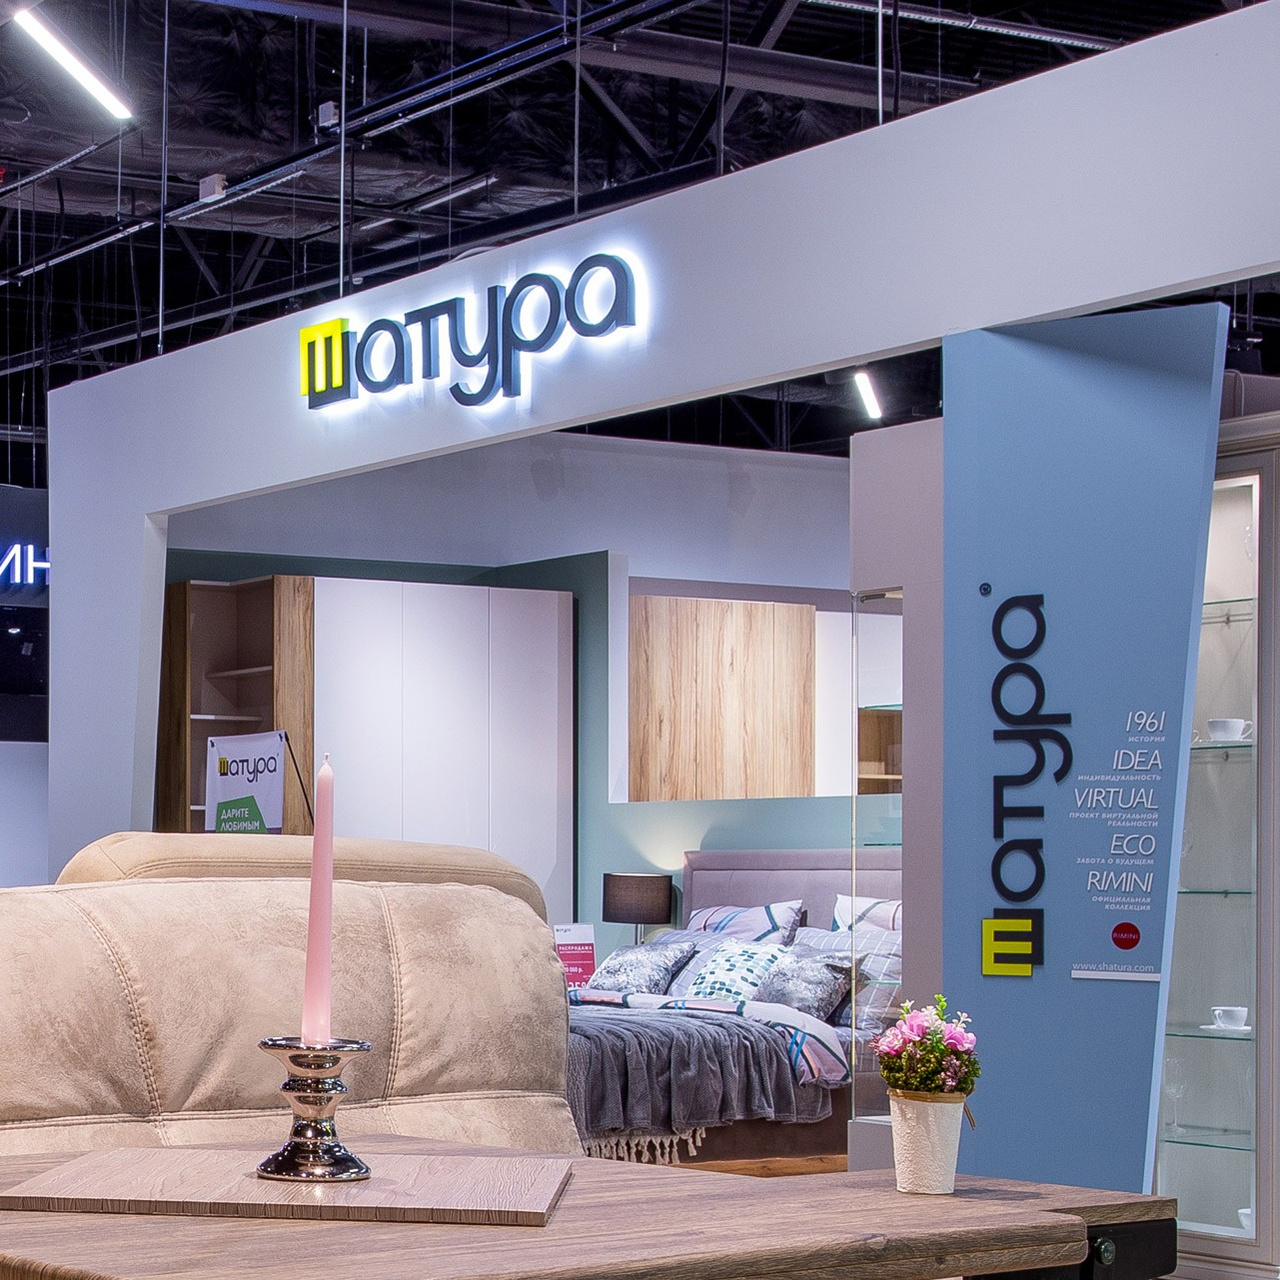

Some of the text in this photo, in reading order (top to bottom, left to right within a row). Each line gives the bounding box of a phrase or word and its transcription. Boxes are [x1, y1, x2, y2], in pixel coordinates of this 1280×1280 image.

[1126, 710, 1166, 732] 1961
[1112, 749, 1162, 770] IDEA
[1077, 774, 1161, 782] ИНДИВИДУАЛЬНОСТЬ
[1074, 787, 1159, 809] VIRTUAL
[221, 808, 249, 820] ДАРИТЕ
[1101, 812, 1159, 820] ВИРТУАЛЬНОЙ
[220, 820, 260, 831] ЛЮБИМЫМ
[1110, 833, 1156, 855] ECO
[1115, 858, 1154, 866] БУДУЩЕМ
[1087, 871, 1154, 892] RIMINI
[1112, 932, 1138, 940] RIMINI
[1072, 962, 1154, 972] www.shatura.com
